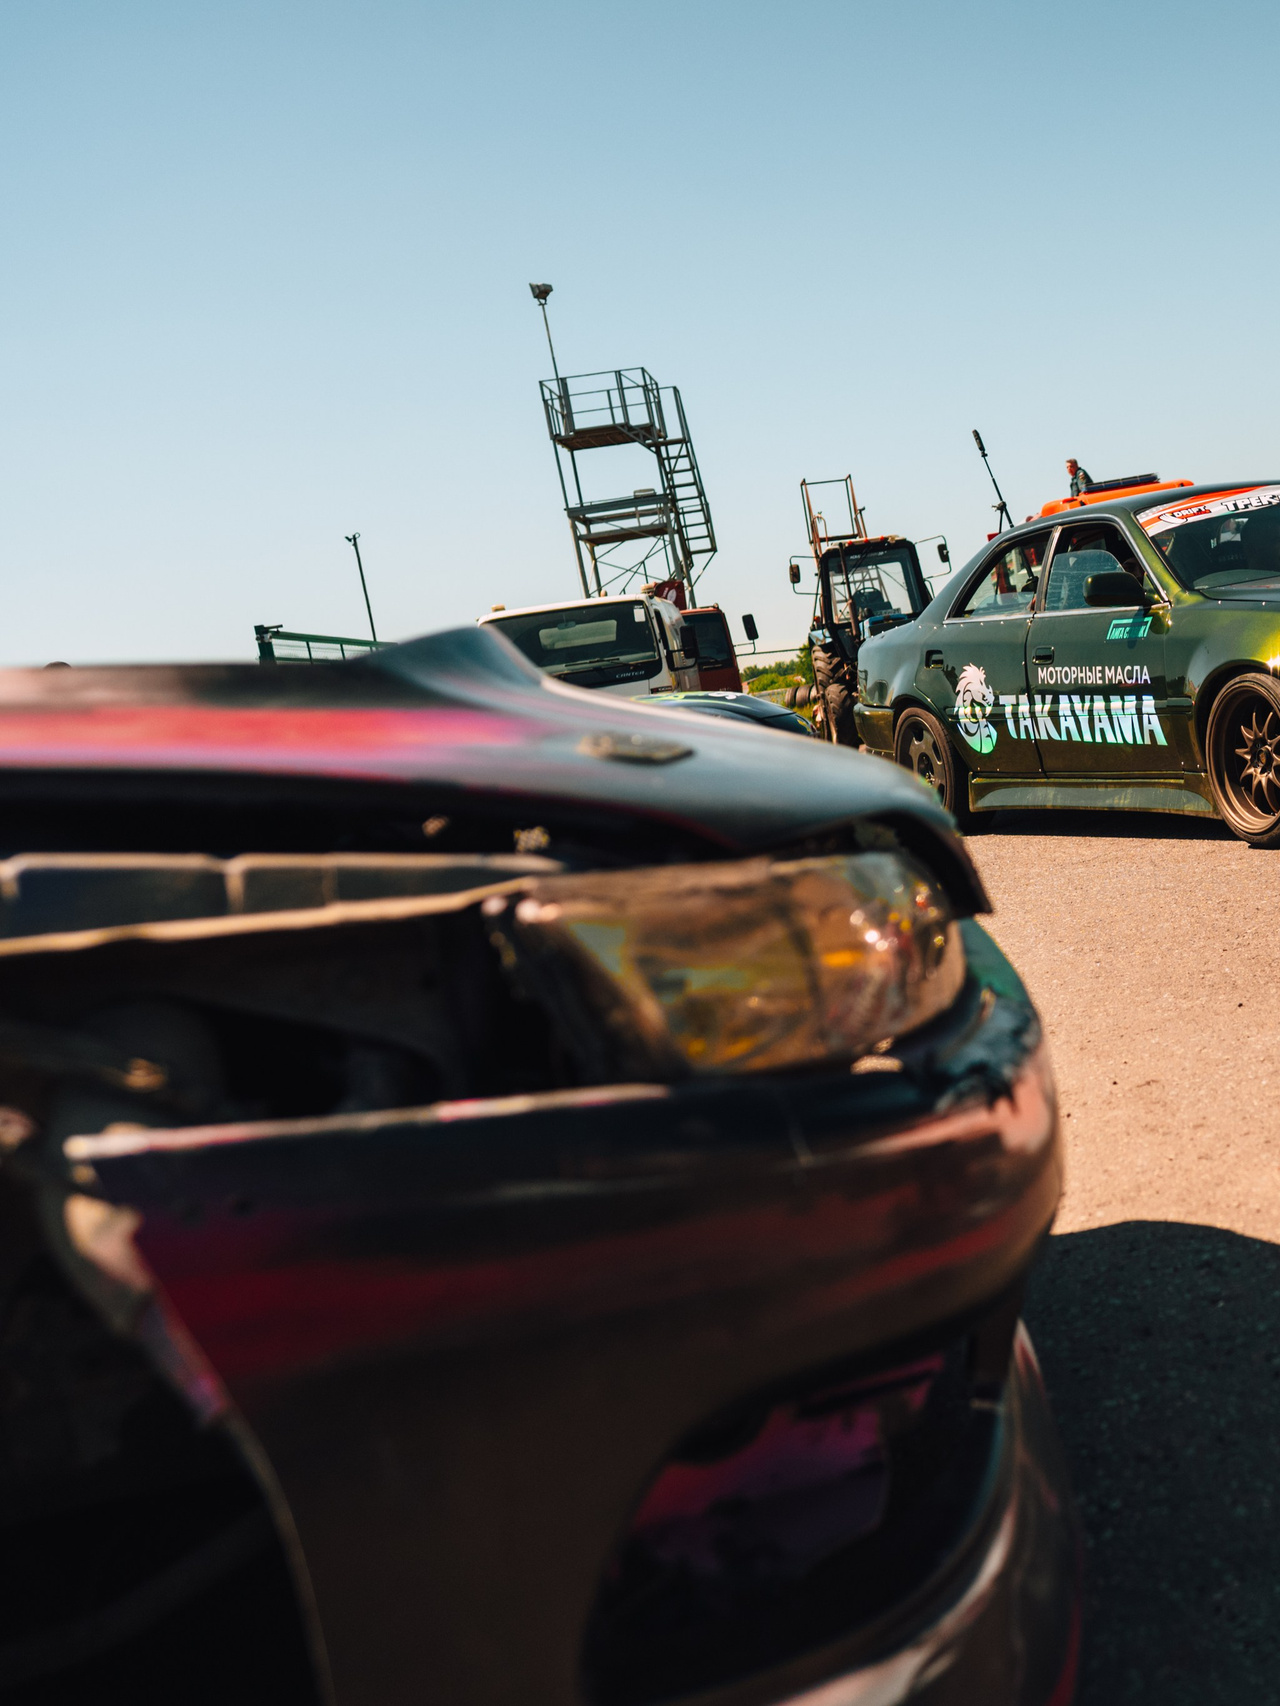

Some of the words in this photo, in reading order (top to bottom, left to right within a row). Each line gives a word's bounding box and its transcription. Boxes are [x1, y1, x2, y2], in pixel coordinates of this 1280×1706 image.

[615, 670, 645, 679] CANTER
[1038, 666, 1102, 685] МОТОРНЫЕ
[1105, 665, 1151, 685] МАСЛА
[999, 694, 1168, 746] TAKAYAMA
